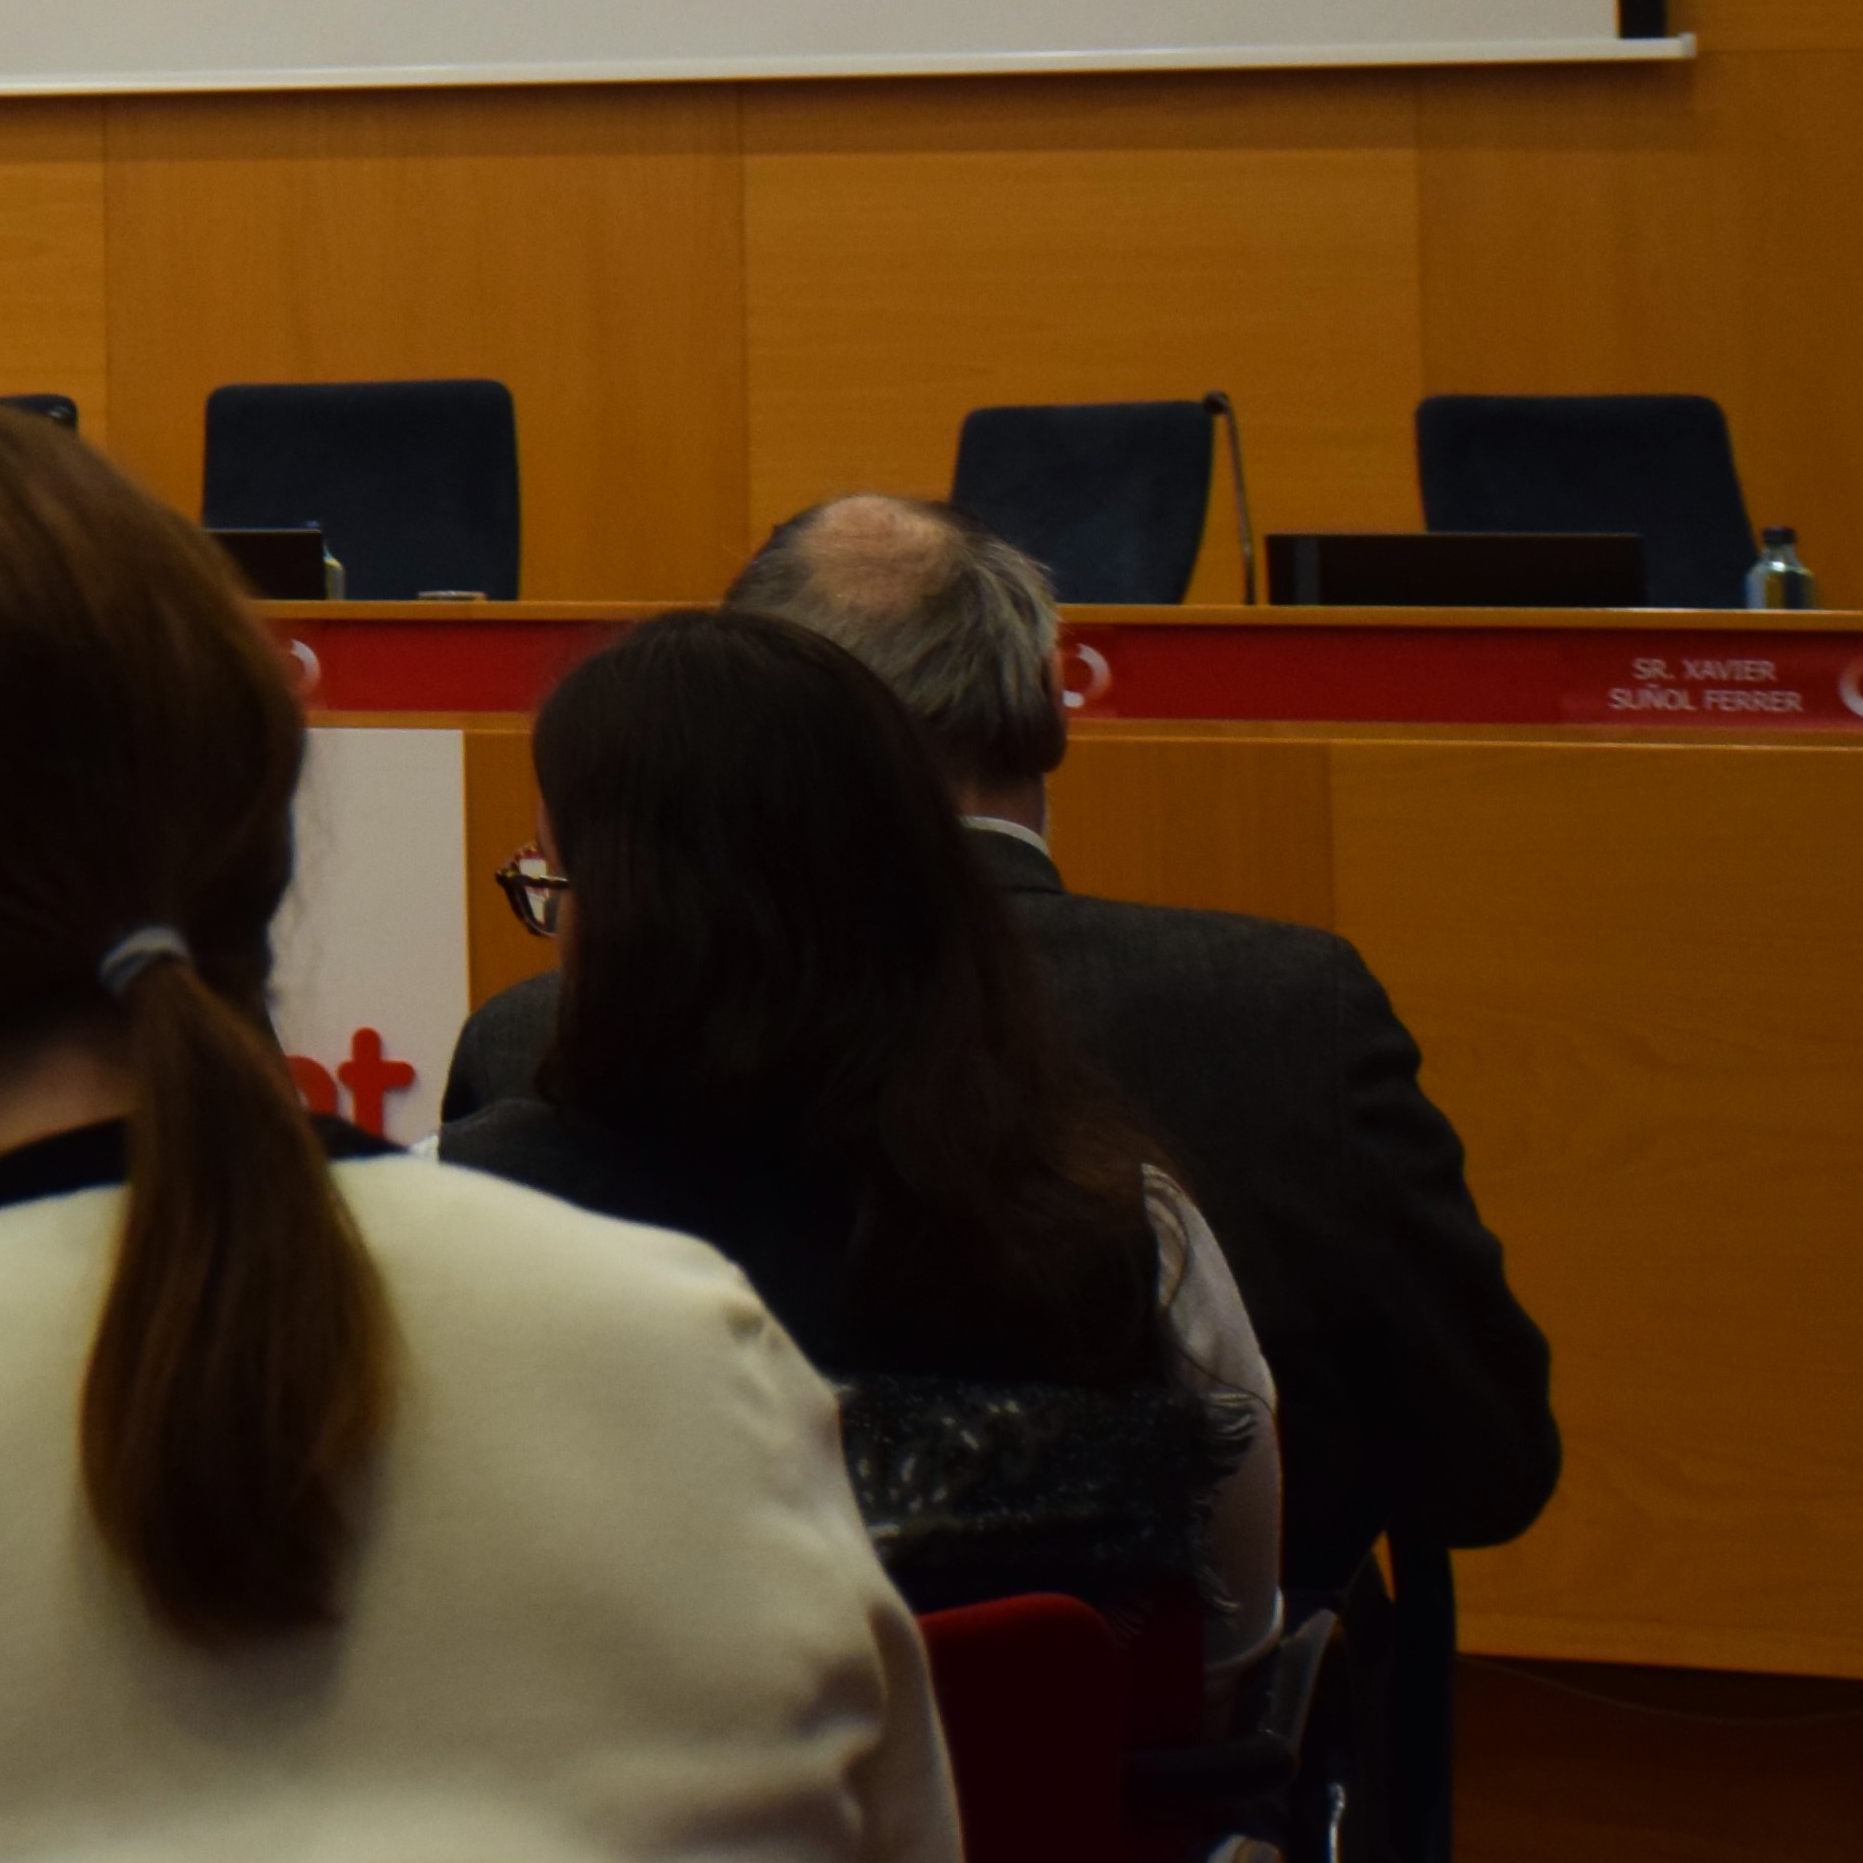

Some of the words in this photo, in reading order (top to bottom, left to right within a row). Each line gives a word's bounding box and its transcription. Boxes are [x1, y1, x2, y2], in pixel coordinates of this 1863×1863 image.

[1632, 657, 1676, 680] SR.
[1681, 658, 1777, 682] XAVIER
[1608, 682, 1698, 711] SUÑOL
[1702, 689, 1804, 712] FERRER
